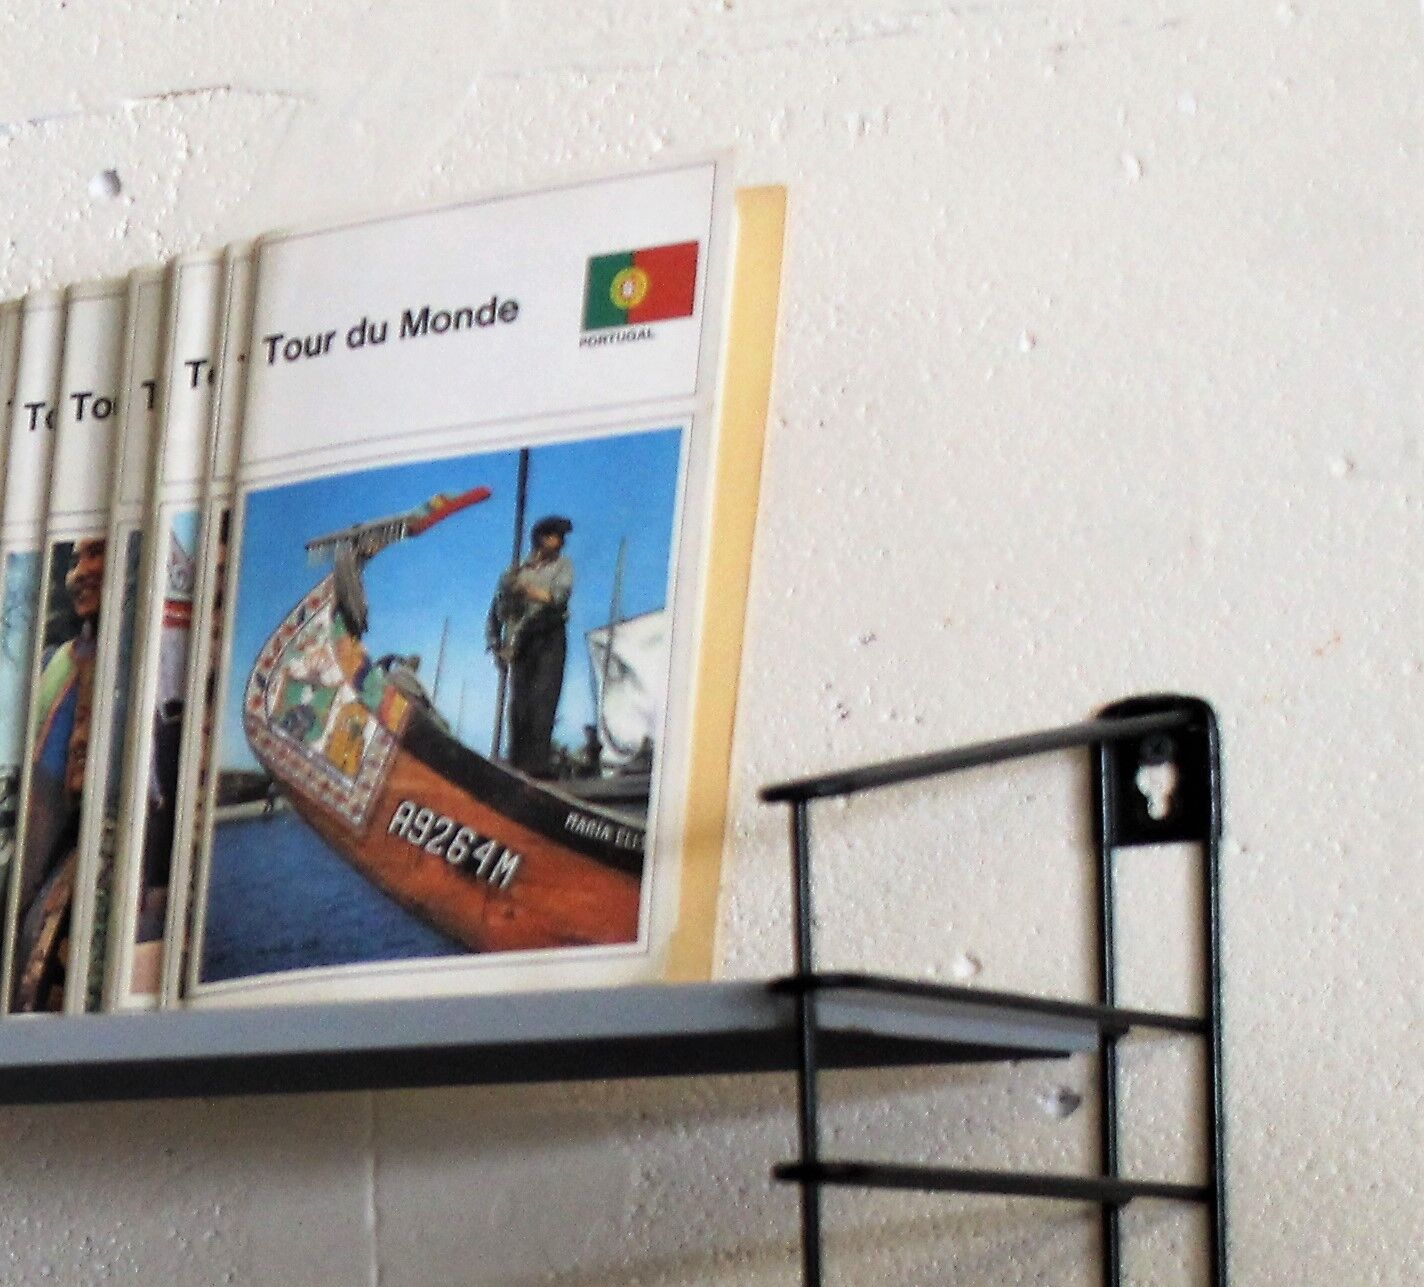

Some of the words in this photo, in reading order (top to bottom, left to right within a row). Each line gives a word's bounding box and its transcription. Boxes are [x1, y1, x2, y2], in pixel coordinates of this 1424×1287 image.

[263, 329, 336, 366] Tour
[346, 316, 388, 350] du
[399, 295, 521, 339] Monde
[388, 800, 523, 890] A9264M
